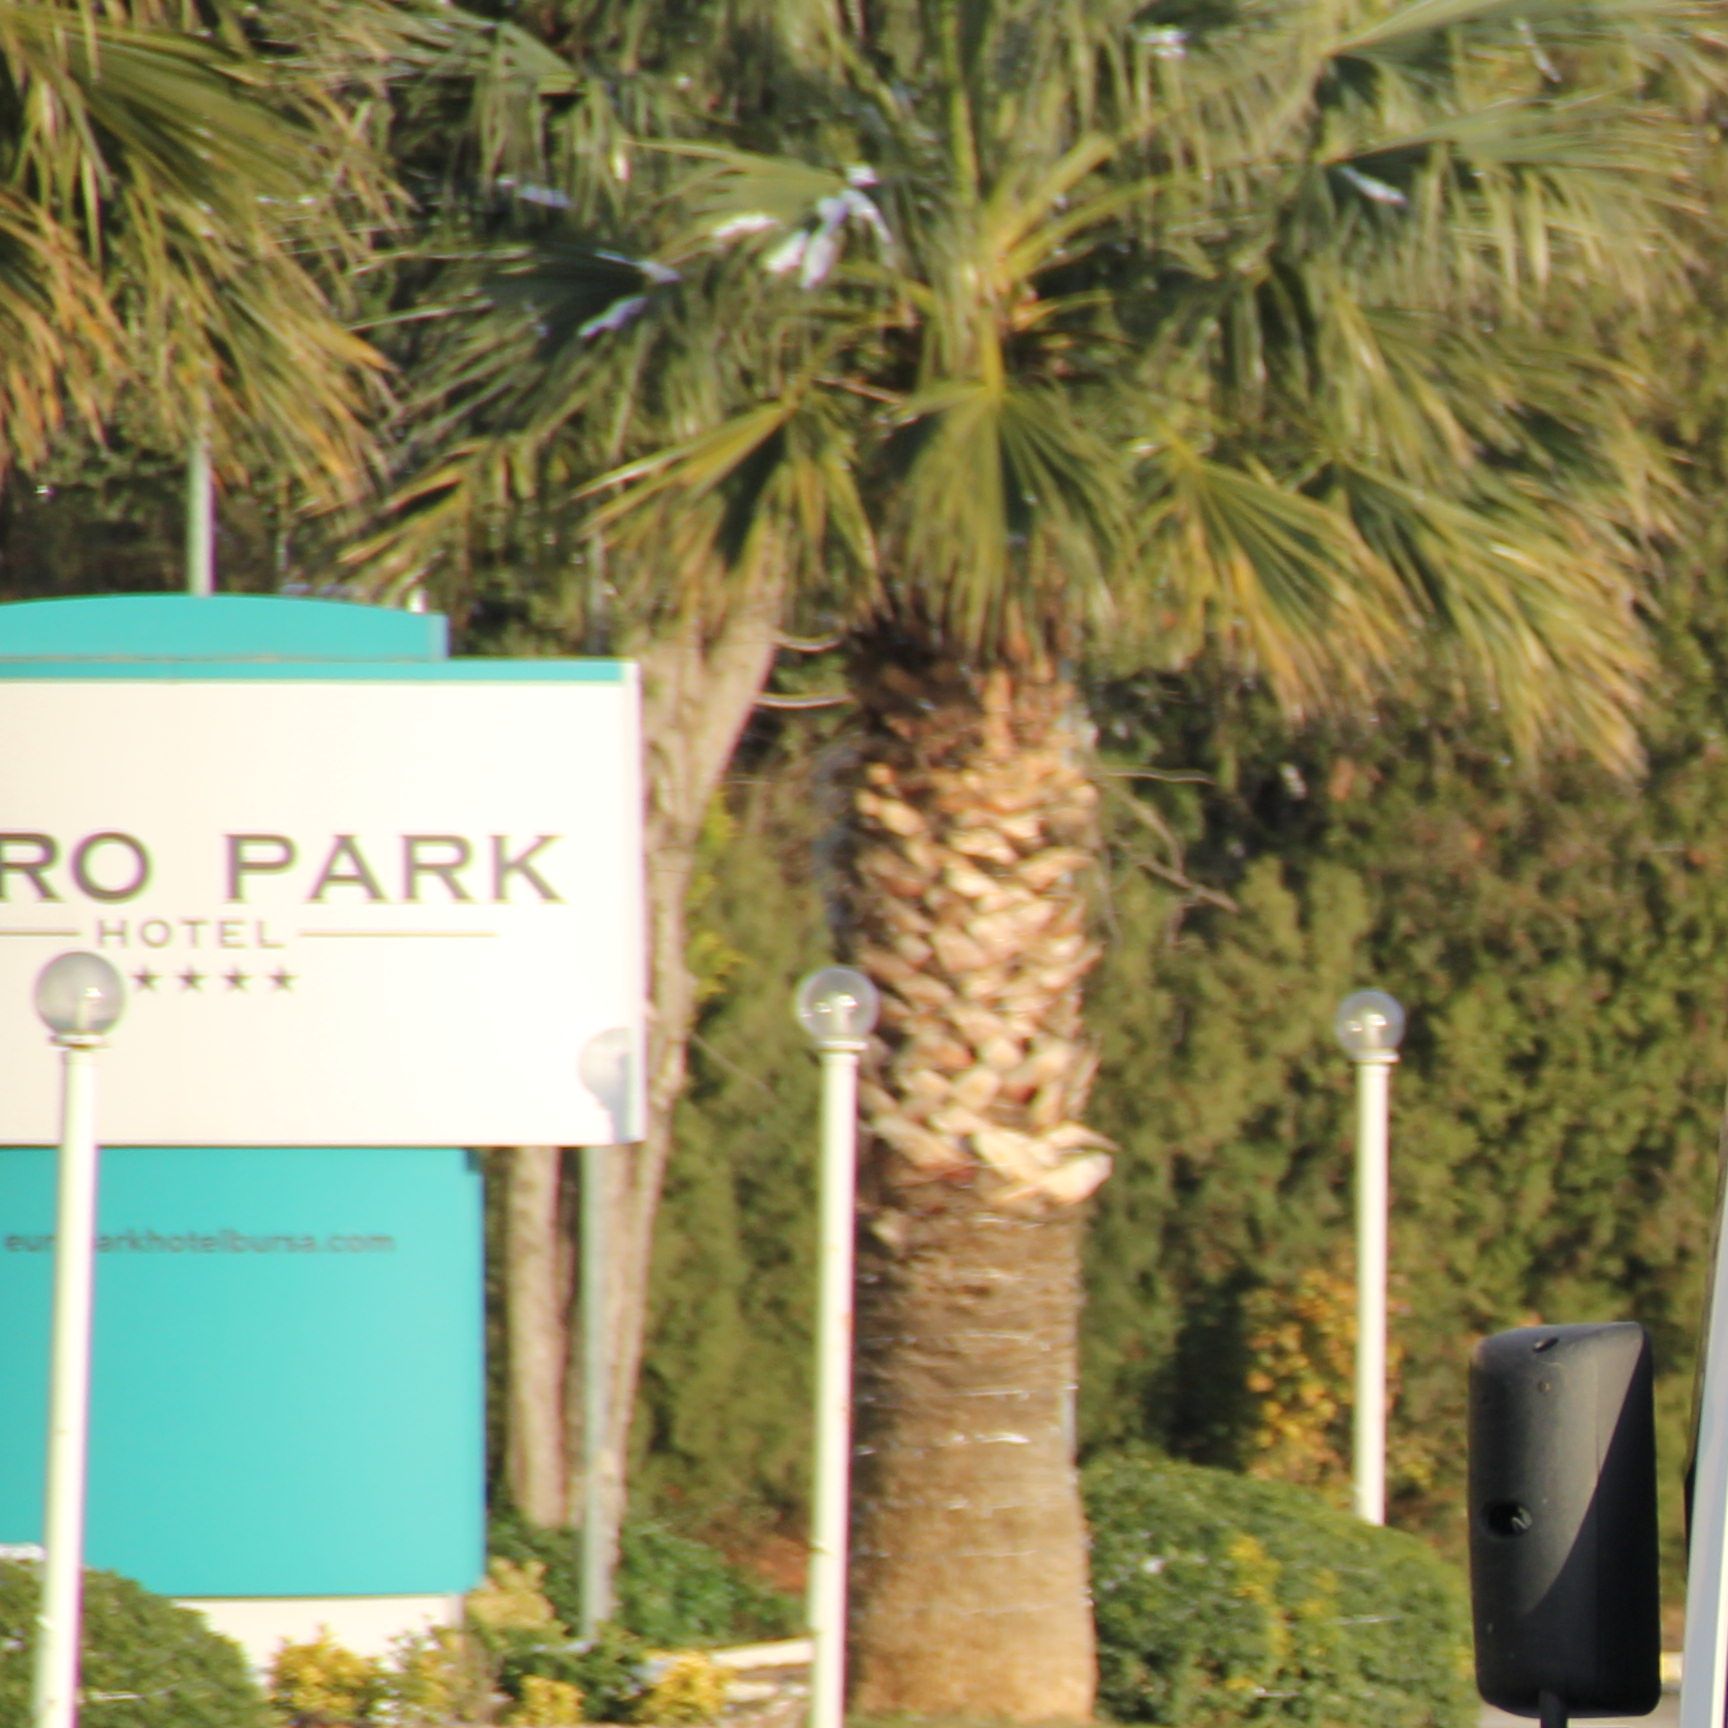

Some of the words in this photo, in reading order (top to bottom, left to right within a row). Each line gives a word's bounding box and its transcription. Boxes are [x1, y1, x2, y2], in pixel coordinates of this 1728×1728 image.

[223, 833, 567, 904] PARK
[97, 918, 287, 950] HOTEL
[4, 1229, 396, 1254] eurarkhotelbursa.com
